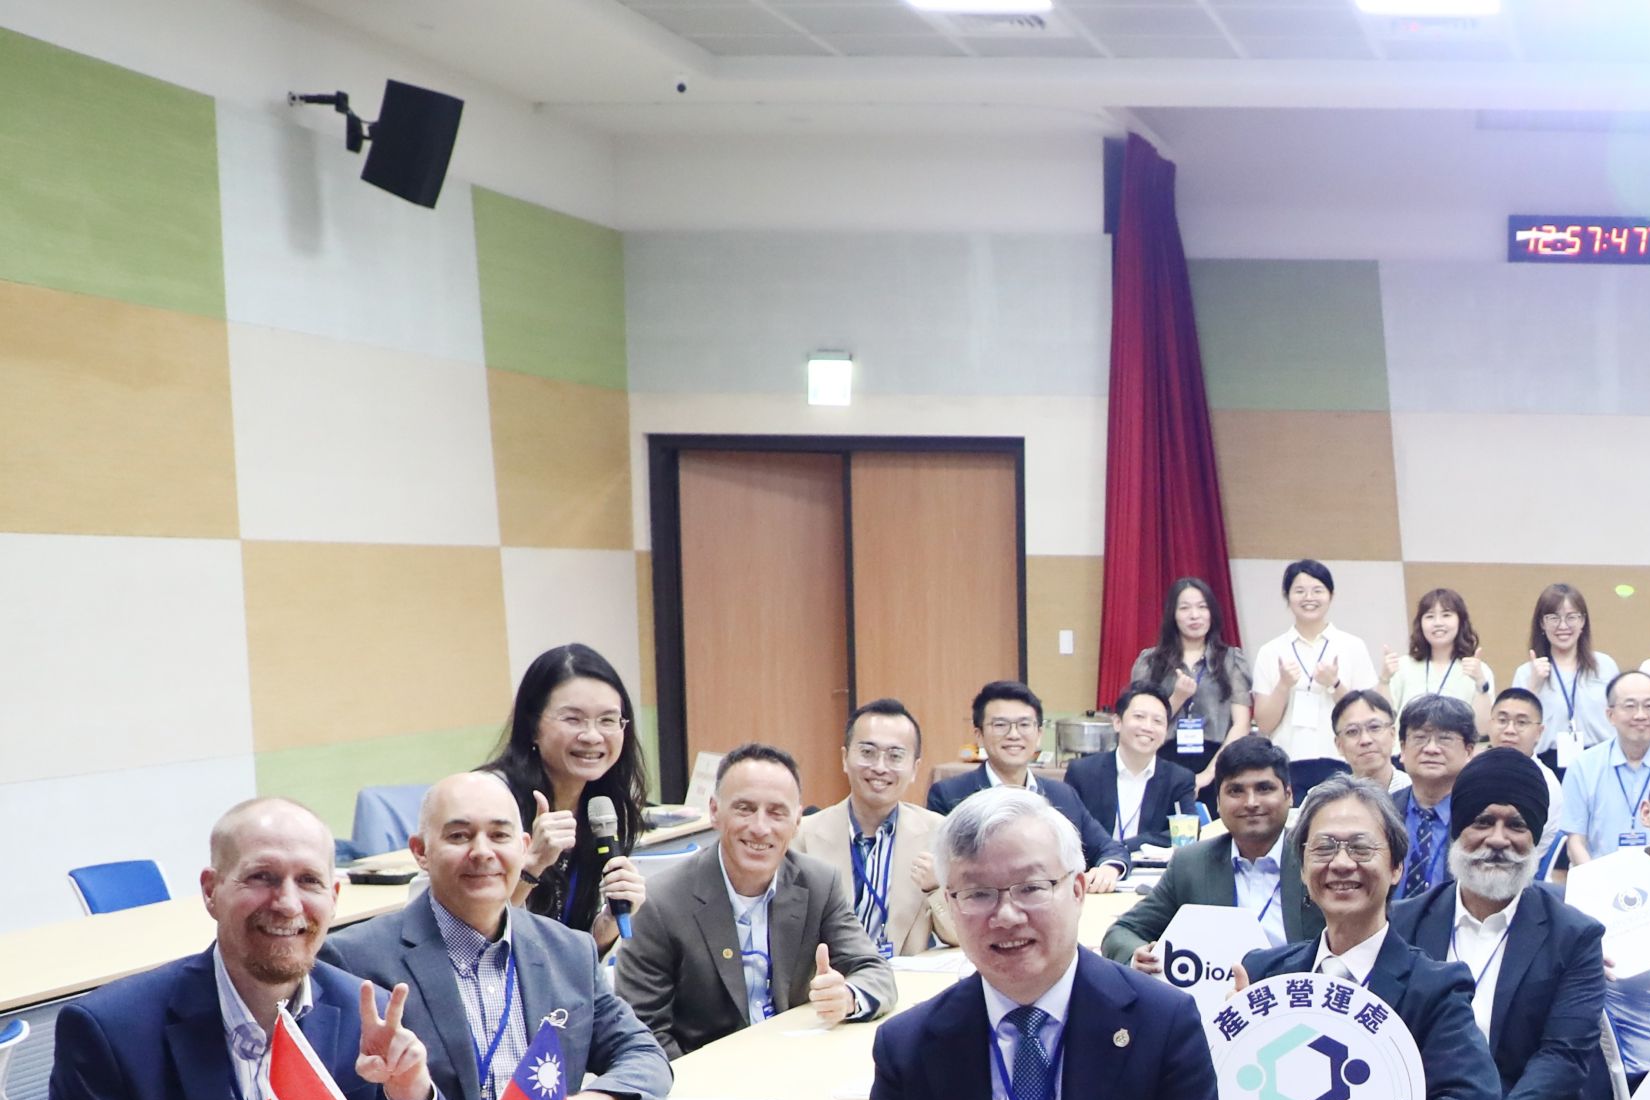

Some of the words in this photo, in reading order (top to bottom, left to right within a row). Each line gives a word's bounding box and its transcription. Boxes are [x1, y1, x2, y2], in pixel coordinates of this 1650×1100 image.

[1213, 979, 1389, 1041] 產學營運處
